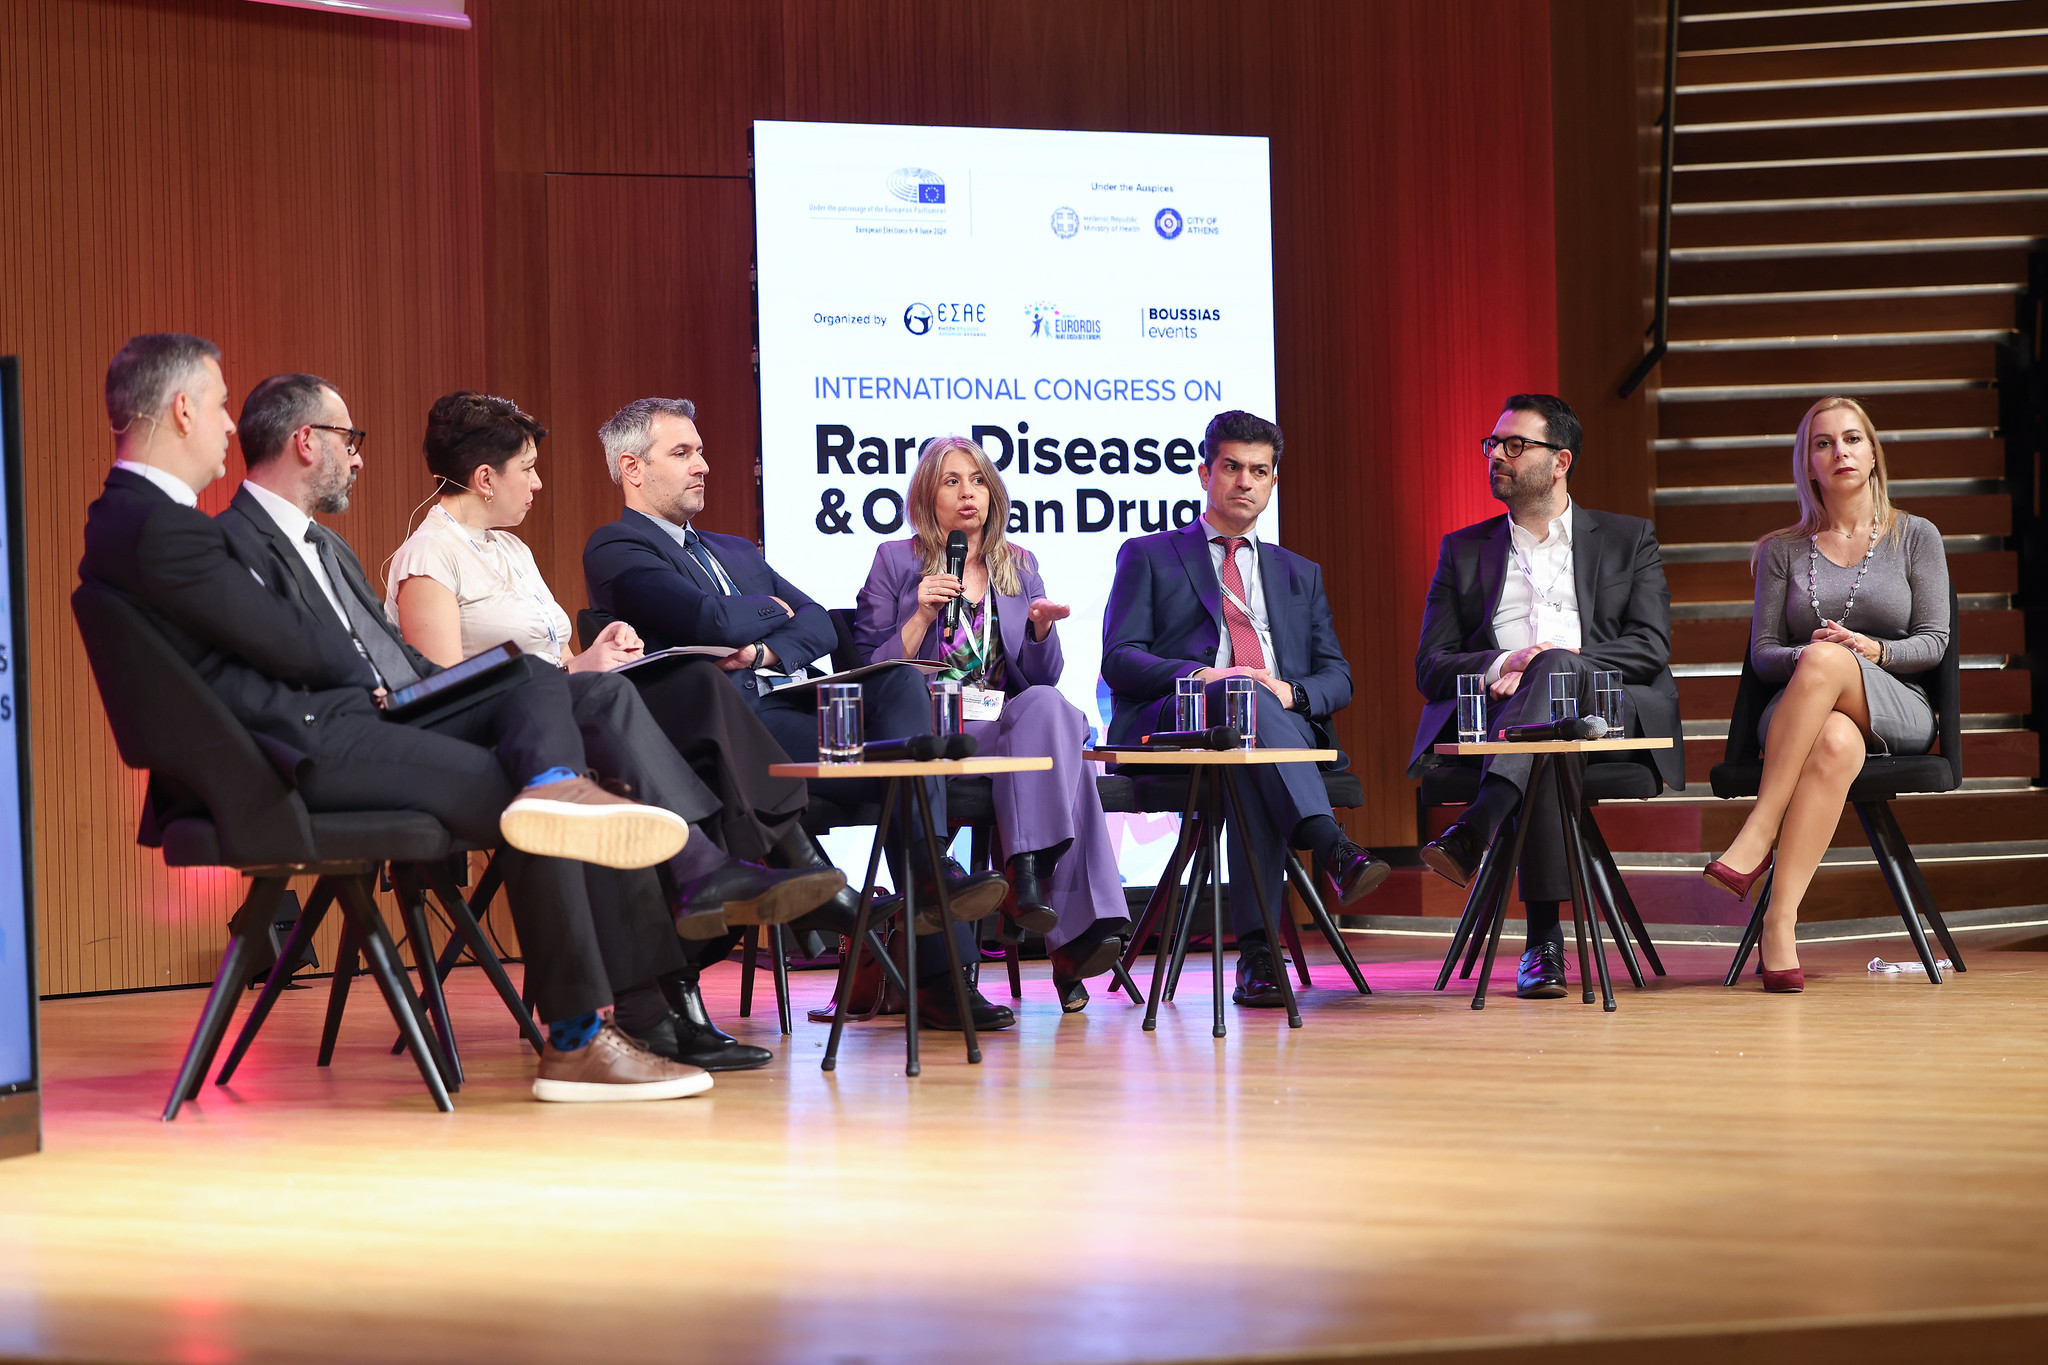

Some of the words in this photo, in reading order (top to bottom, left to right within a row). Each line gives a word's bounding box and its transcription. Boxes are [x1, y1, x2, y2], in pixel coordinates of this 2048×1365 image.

[1091, 182, 1117, 192] Under
[1120, 183, 1133, 192] the
[1136, 184, 1174, 194] Auspices
[808, 203, 826, 211] Under
[827, 204, 837, 212] the
[838, 204, 866, 214] patronage
[867, 205, 874, 213] of
[874, 205, 884, 213] the
[885, 206, 912, 214] European
[1187, 217, 1204, 226] CITY
[1206, 217, 1218, 226] OF
[855, 225, 882, 235] European
[883, 226, 908, 235] Elections
[919, 227, 932, 236] June
[933, 227, 947, 236] 2024
[1083, 225, 1110, 234] Ministry
[1111, 225, 1119, 233] of
[1119, 226, 1141, 234] Health
[1187, 226, 1220, 236] ATHENS
[813, 312, 871, 327] Organized
[873, 314, 888, 327] by
[1148, 307, 1221, 322] BOUSSIAS
[1055, 318, 1101, 334] EURORDIS
[1148, 325, 1198, 340] events
[815, 376, 1026, 401] INTERNATIONAL
[1033, 378, 1177, 402] CONGRESS
[1183, 379, 1222, 402] ON
[972, 420, 1206, 475] Disease
[815, 488, 854, 535] &
[862, 488, 1064, 534] Oan
[1076, 488, 1201, 534] Drug
